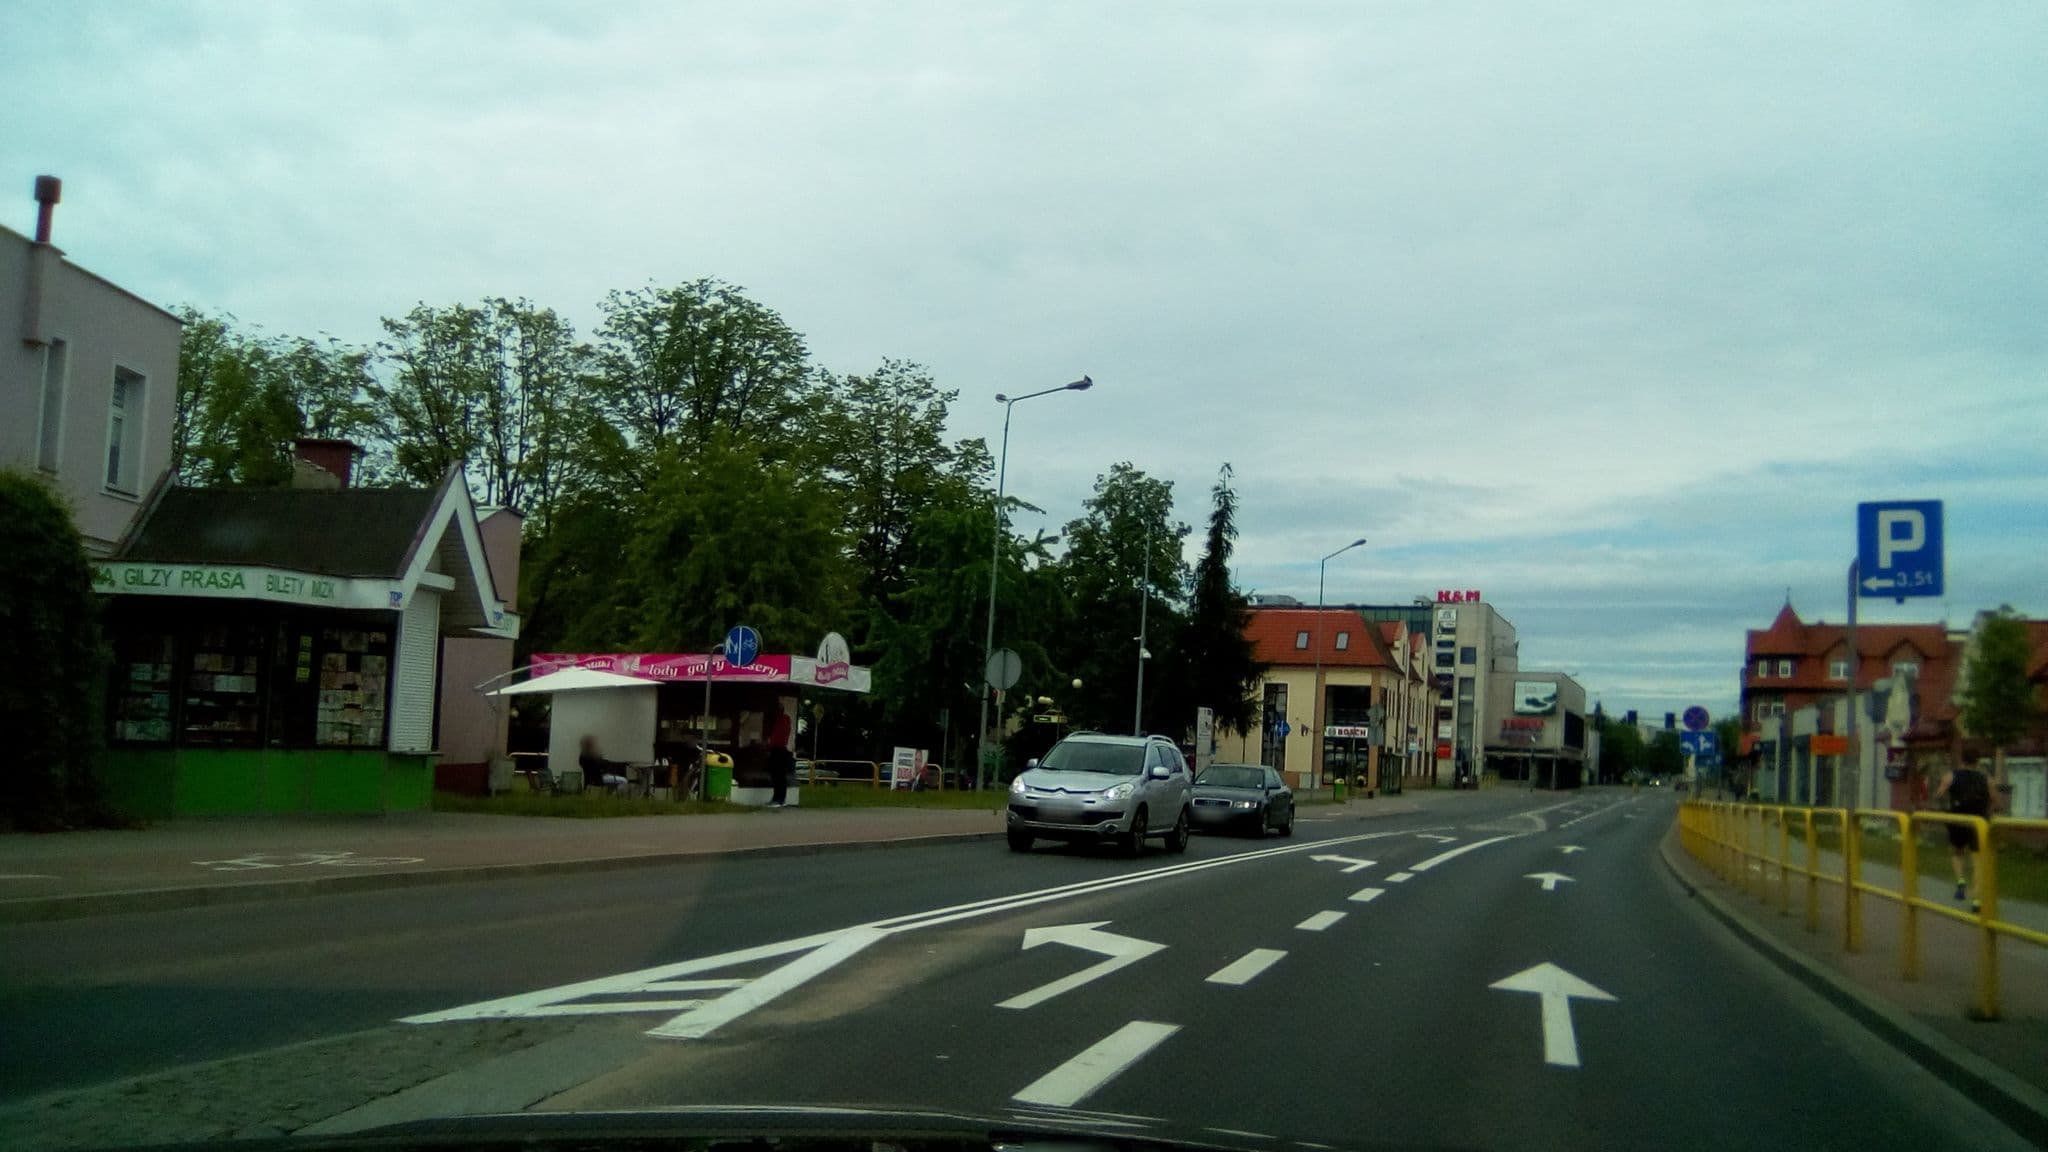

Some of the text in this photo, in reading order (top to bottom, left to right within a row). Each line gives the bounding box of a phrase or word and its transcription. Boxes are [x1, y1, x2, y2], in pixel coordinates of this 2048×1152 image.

[1878, 509, 1926, 569] P
[124, 568, 173, 587] GILZY
[181, 570, 246, 590] PRASA
[266, 574, 306, 596] BILETY
[648, 664, 679, 677] lody
[687, 660, 725, 676] gofy
